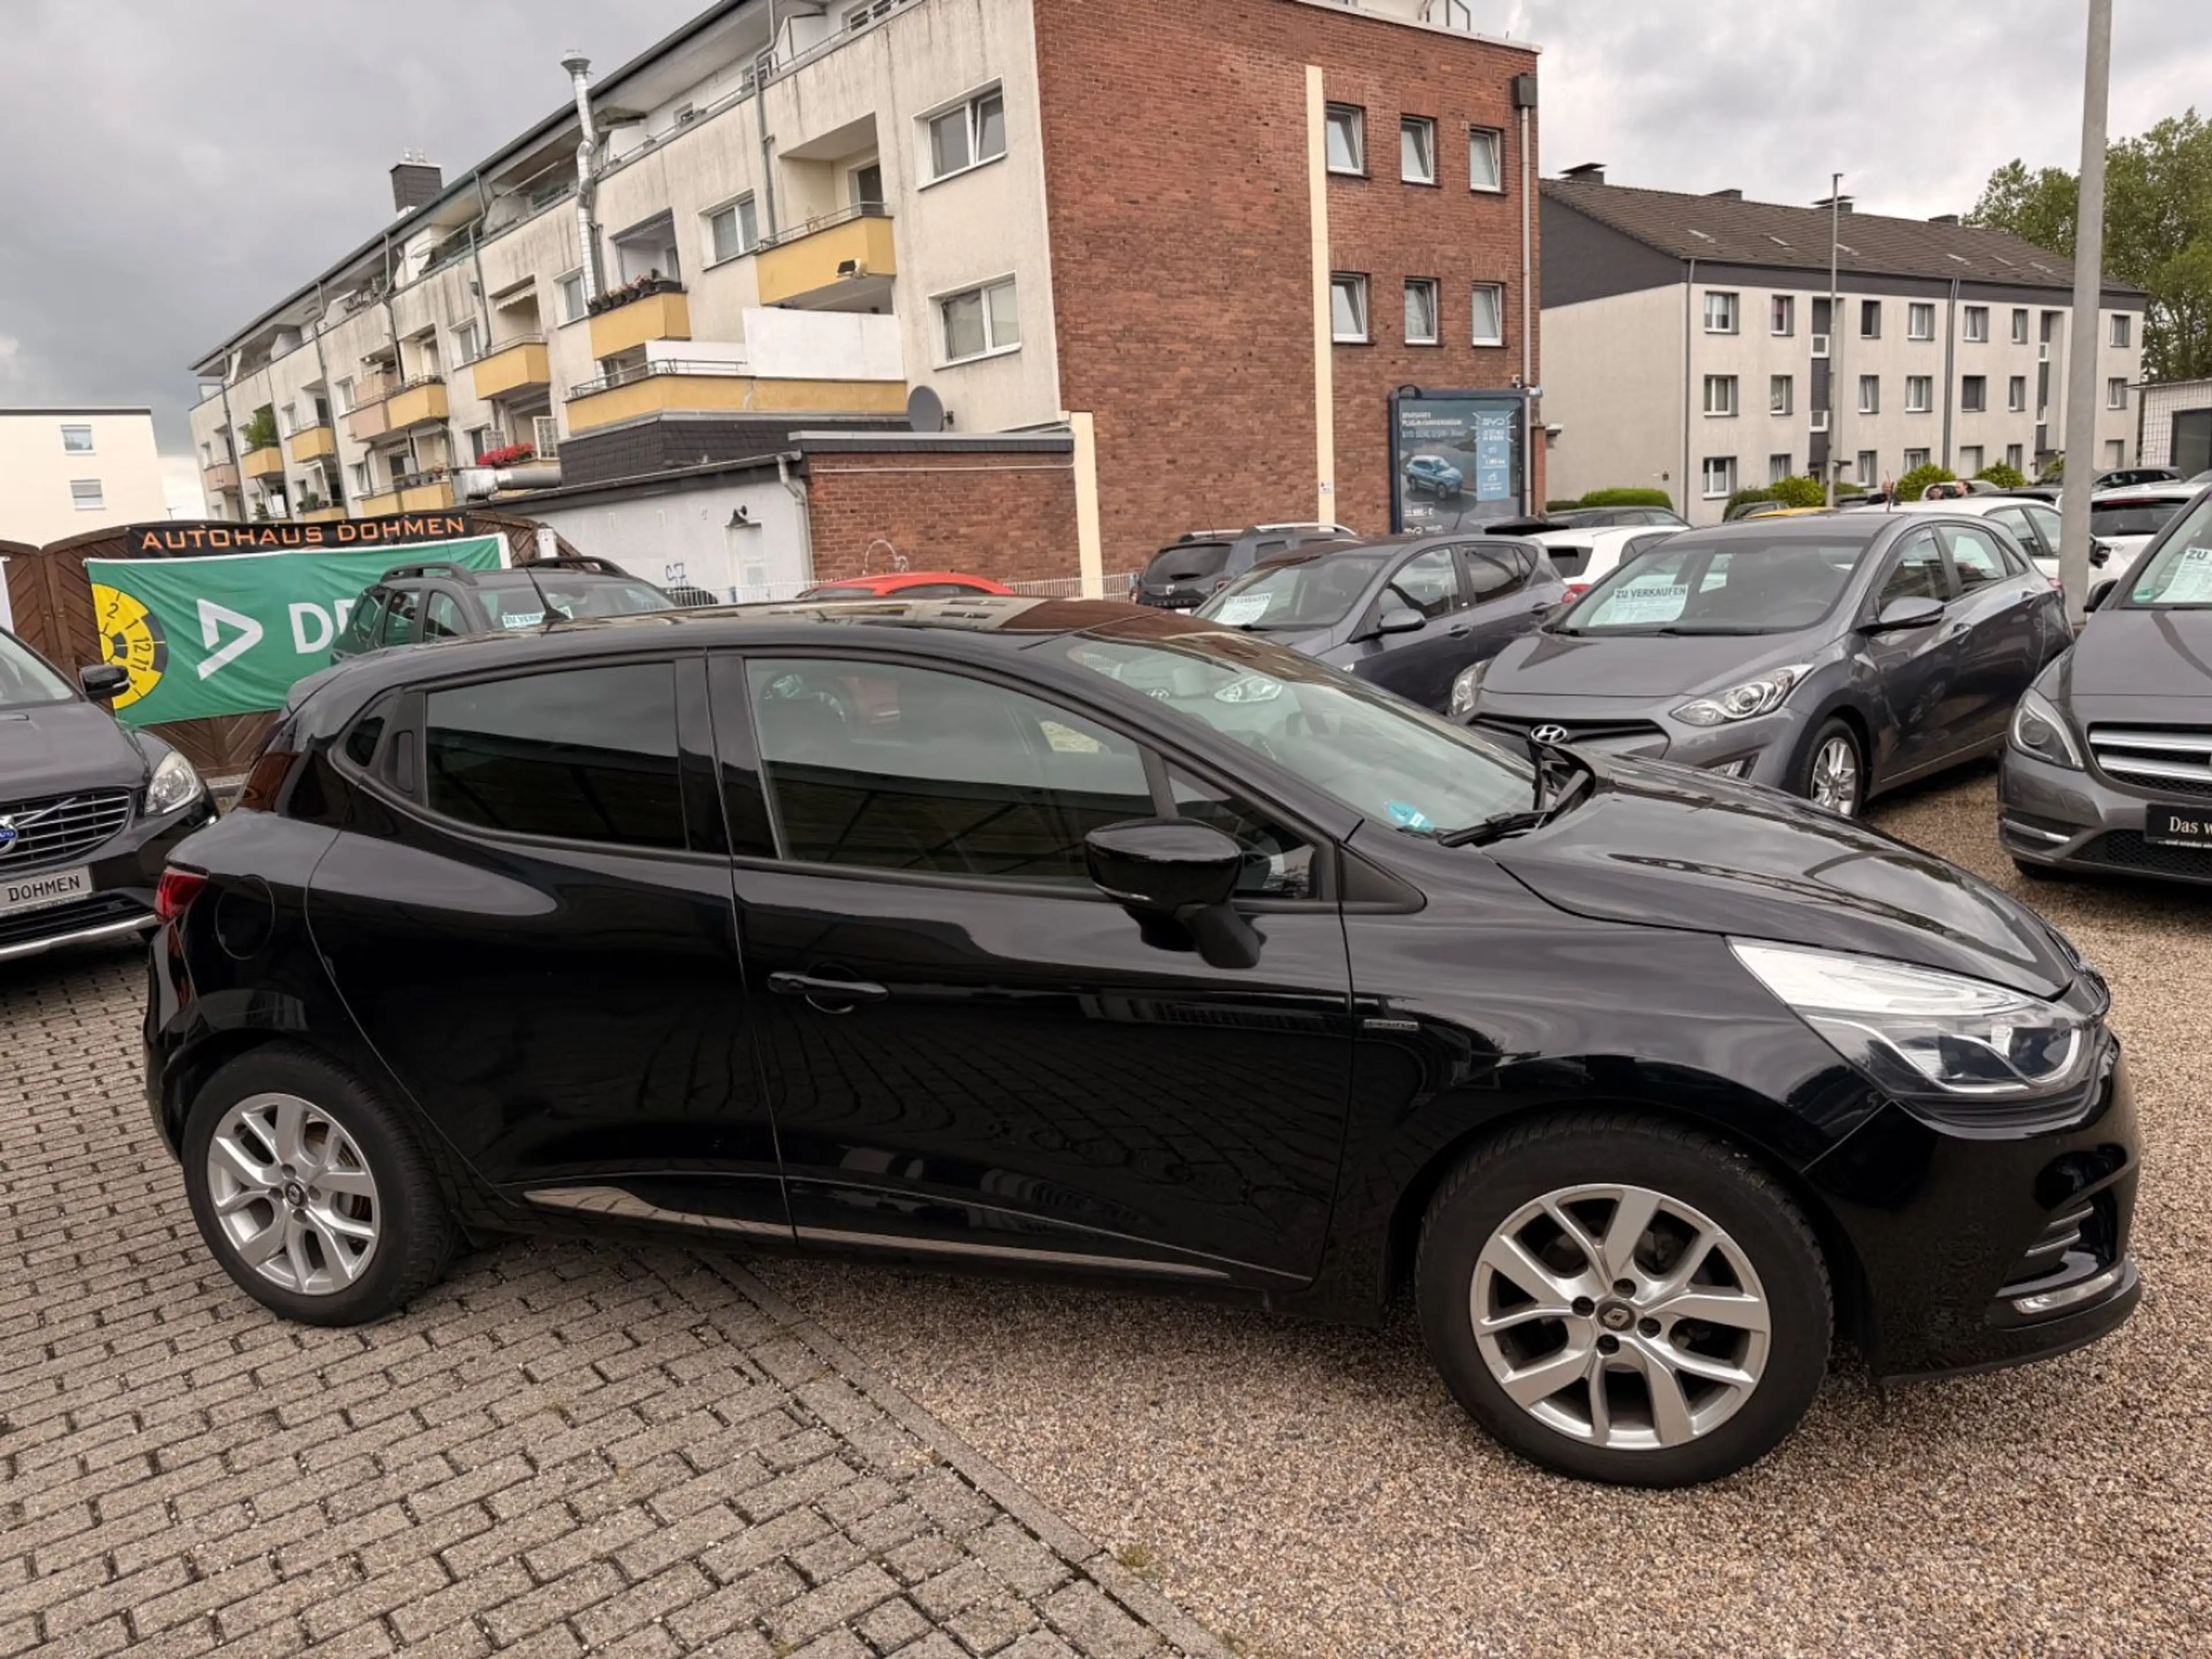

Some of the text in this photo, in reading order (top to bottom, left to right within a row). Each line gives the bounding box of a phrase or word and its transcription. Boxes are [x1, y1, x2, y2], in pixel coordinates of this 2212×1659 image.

[142, 517, 464, 550] AUTOHAUS DOHMEN
[2186, 549, 2209, 560] ZU
[107, 603, 119, 619] 2
[132, 636, 152, 653] 12
[130, 656, 150, 672] 11
[2169, 816, 2199, 834] Das
[7, 874, 80, 902] DOHMEN
